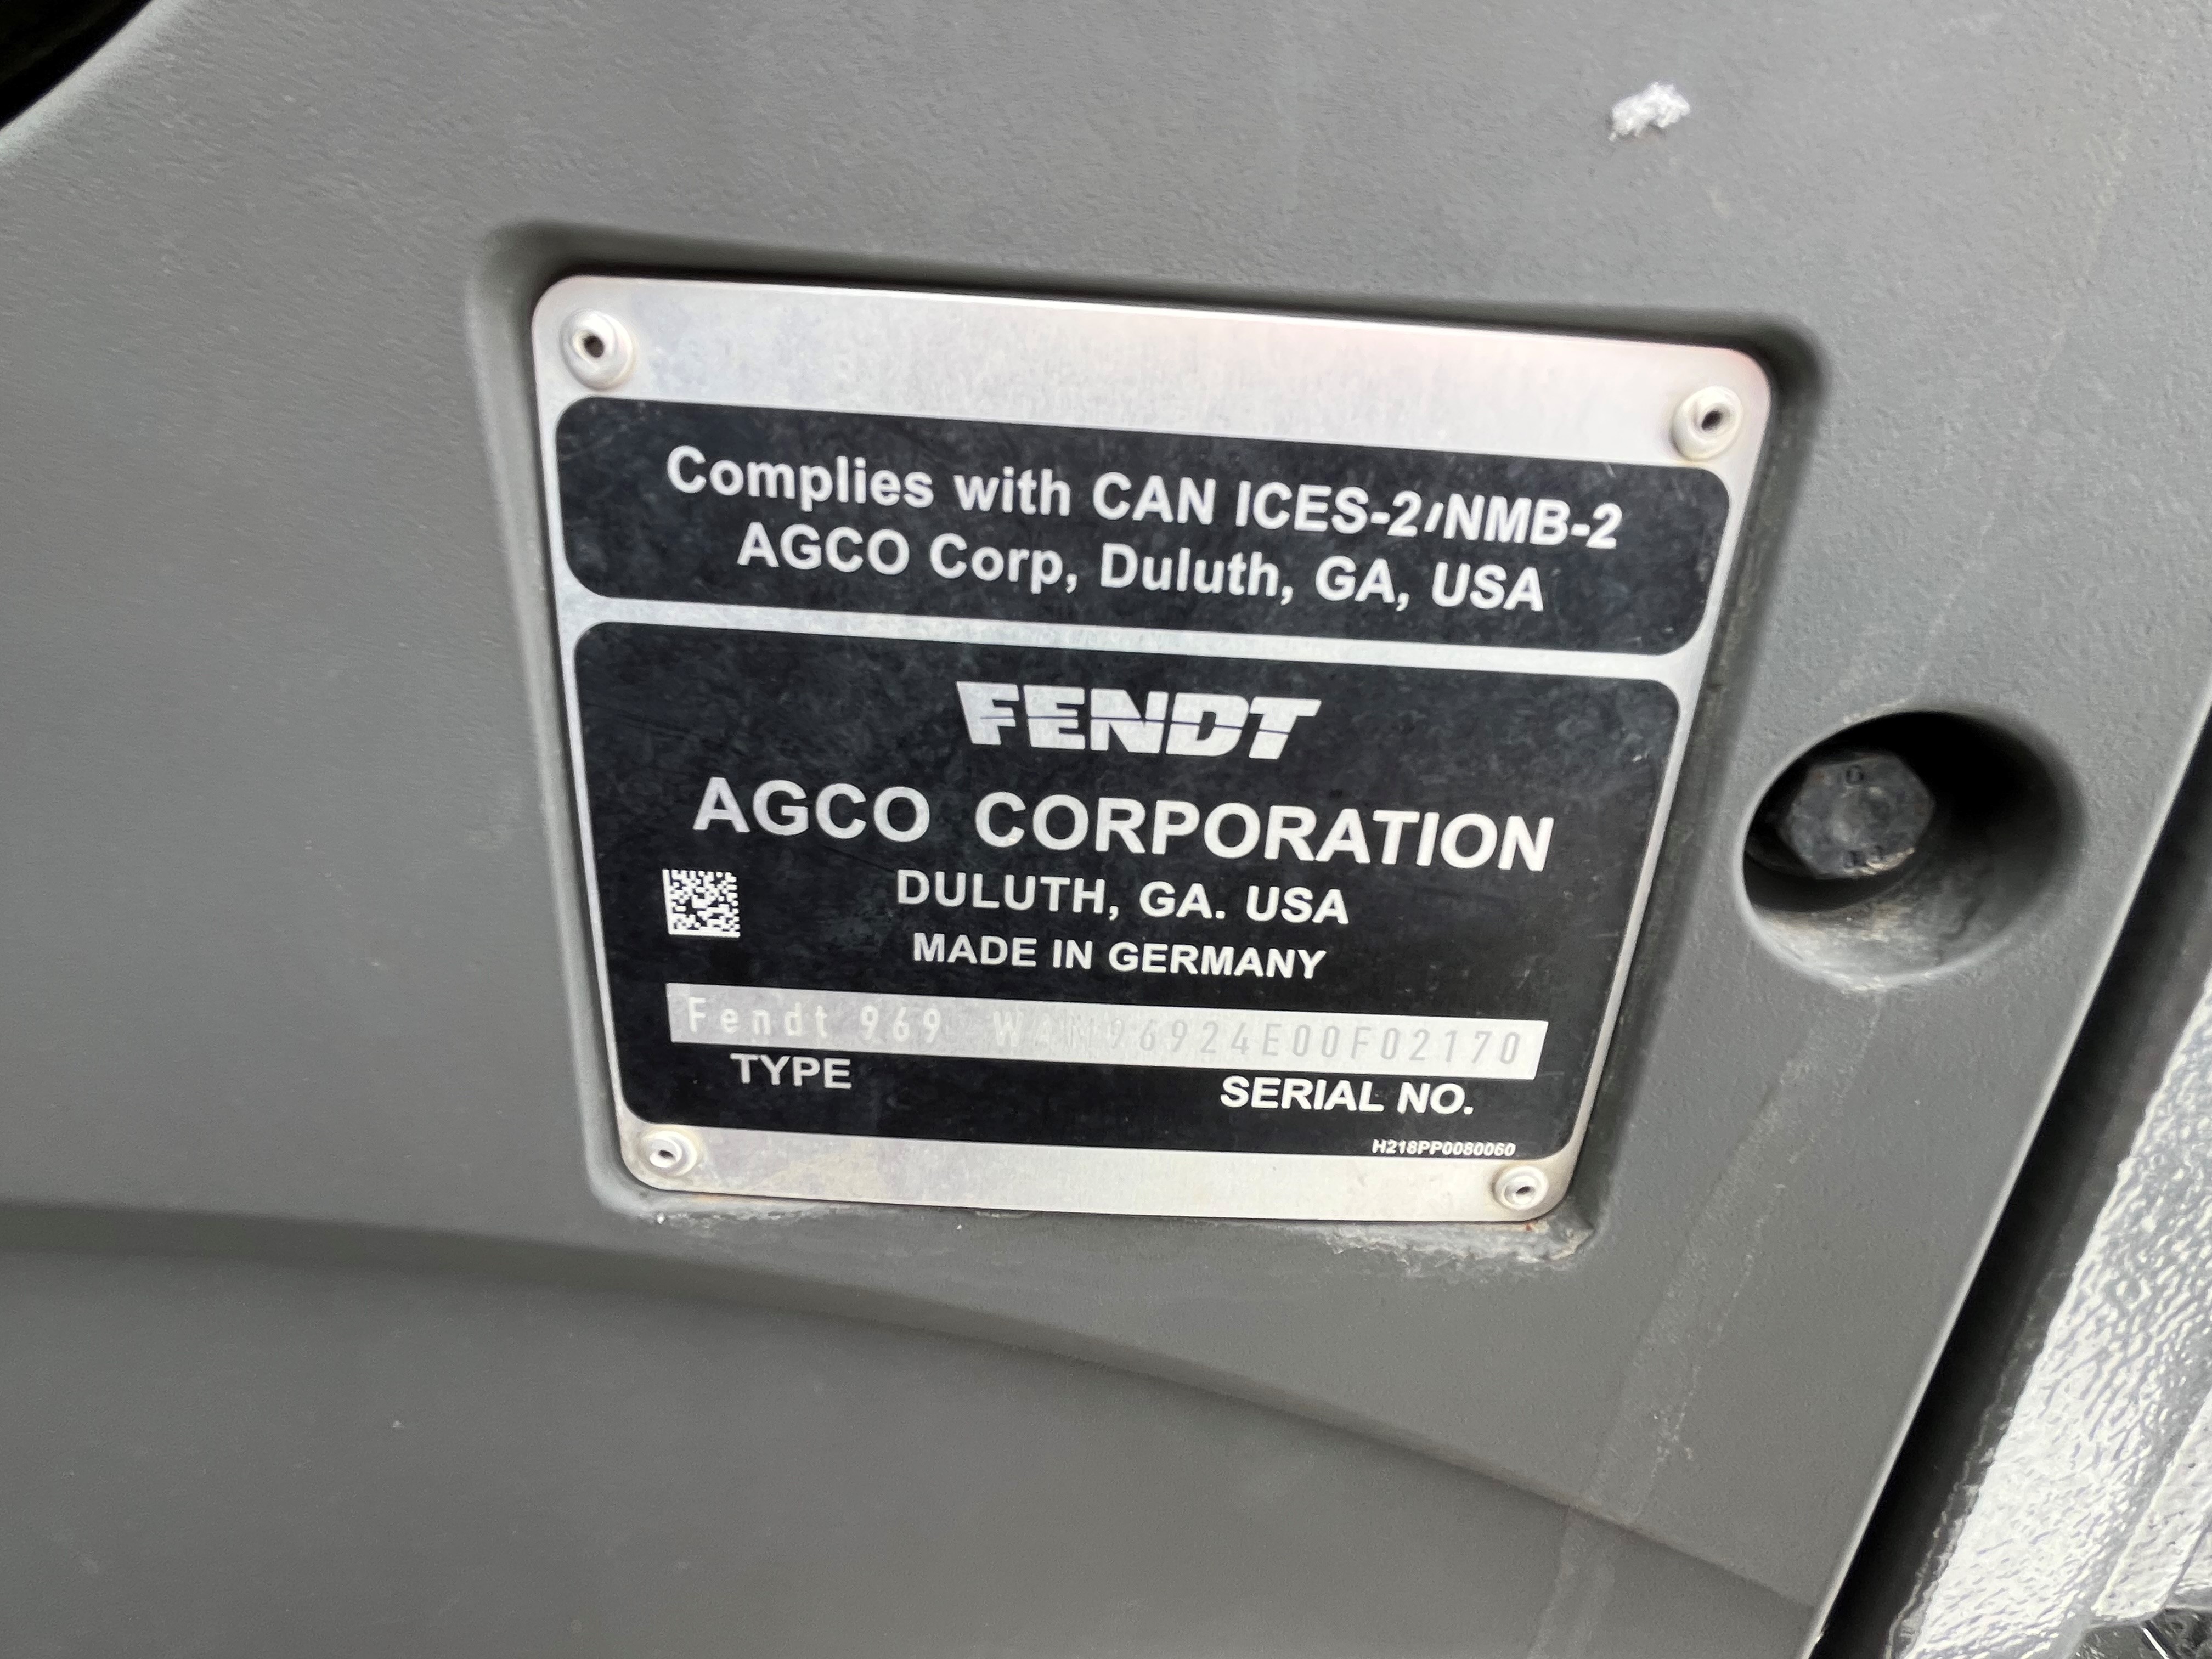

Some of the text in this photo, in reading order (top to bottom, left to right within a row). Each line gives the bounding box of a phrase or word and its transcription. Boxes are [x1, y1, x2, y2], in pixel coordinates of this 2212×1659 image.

[666, 444, 1624, 550] Complies with CAN ICES-2/NMB-2
[736, 521, 1544, 613] AGCO Corp, Duluth, GA, USA
[956, 680, 1322, 760] FENDT
[692, 776, 1555, 873] AGCO CORPORATION
[897, 868, 1350, 926] DULUTH, GA. USA
[913, 932, 1328, 980] MADE IN GERMANY
[688, 996, 941, 1043] Fendt 969
[729, 1052, 853, 1090] TYPE
[1220, 1075, 1475, 1116] SERIAL NO.
[1370, 1138, 1517, 1158] H218PP0080060
